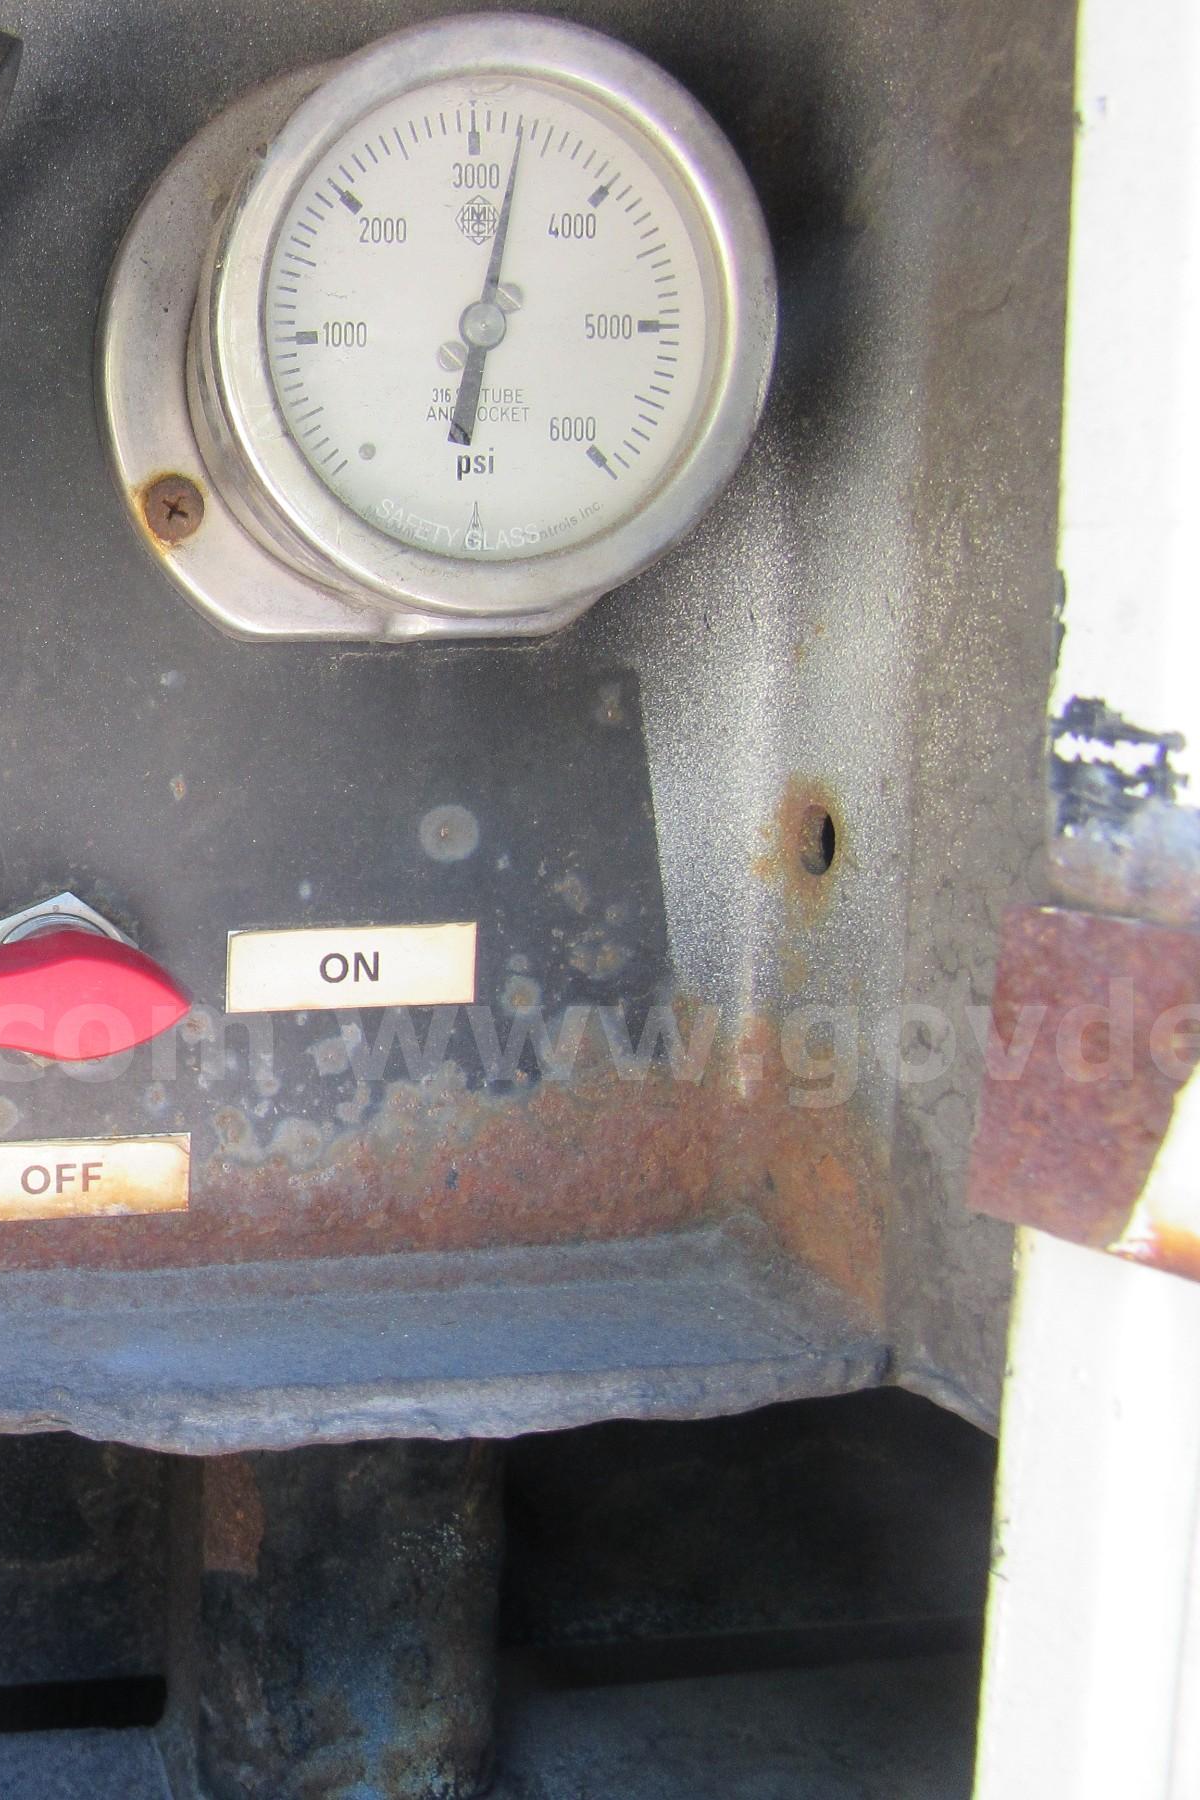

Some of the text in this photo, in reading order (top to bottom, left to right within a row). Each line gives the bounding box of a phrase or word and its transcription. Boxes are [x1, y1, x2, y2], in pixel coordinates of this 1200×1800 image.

[451, 162, 500, 189] 3000
[358, 216, 408, 244] 2000
[547, 212, 598, 240] 4000
[322, 321, 368, 349] 1000
[583, 312, 633, 341] 5000
[432, 387, 452, 403] 316
[481, 388, 525, 404] TUBE
[475, 406, 531, 422] OCKET
[548, 415, 598, 442] 6000
[456, 446, 495, 481] psi
[578, 501, 604, 519] Inc.
[375, 498, 461, 547] SAFETY
[464, 522, 540, 551] GLASS
[319, 951, 381, 984] ON
[20, 1162, 104, 1195] OFF
